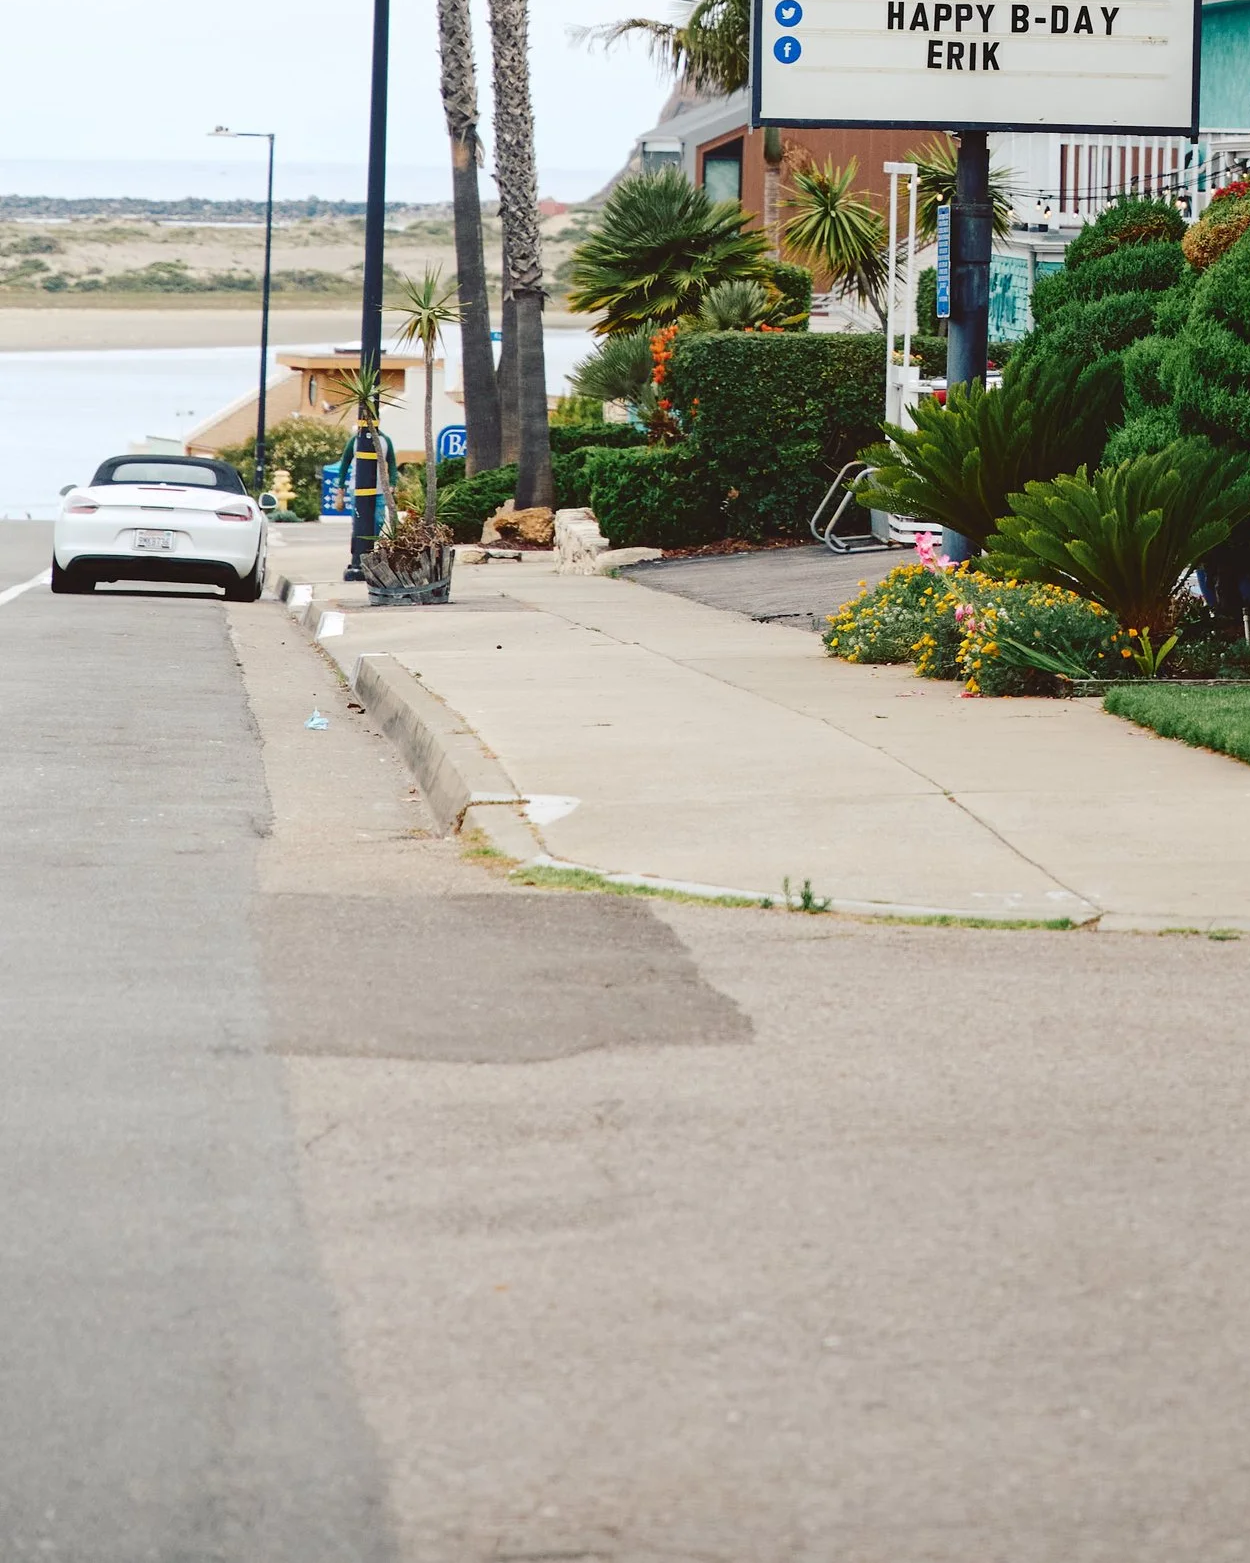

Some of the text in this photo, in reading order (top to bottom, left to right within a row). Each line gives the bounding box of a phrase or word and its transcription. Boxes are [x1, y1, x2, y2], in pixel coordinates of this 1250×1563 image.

[887, 1, 1120, 36] HAPPY B-DAY
[926, 39, 1001, 71] ERIK
